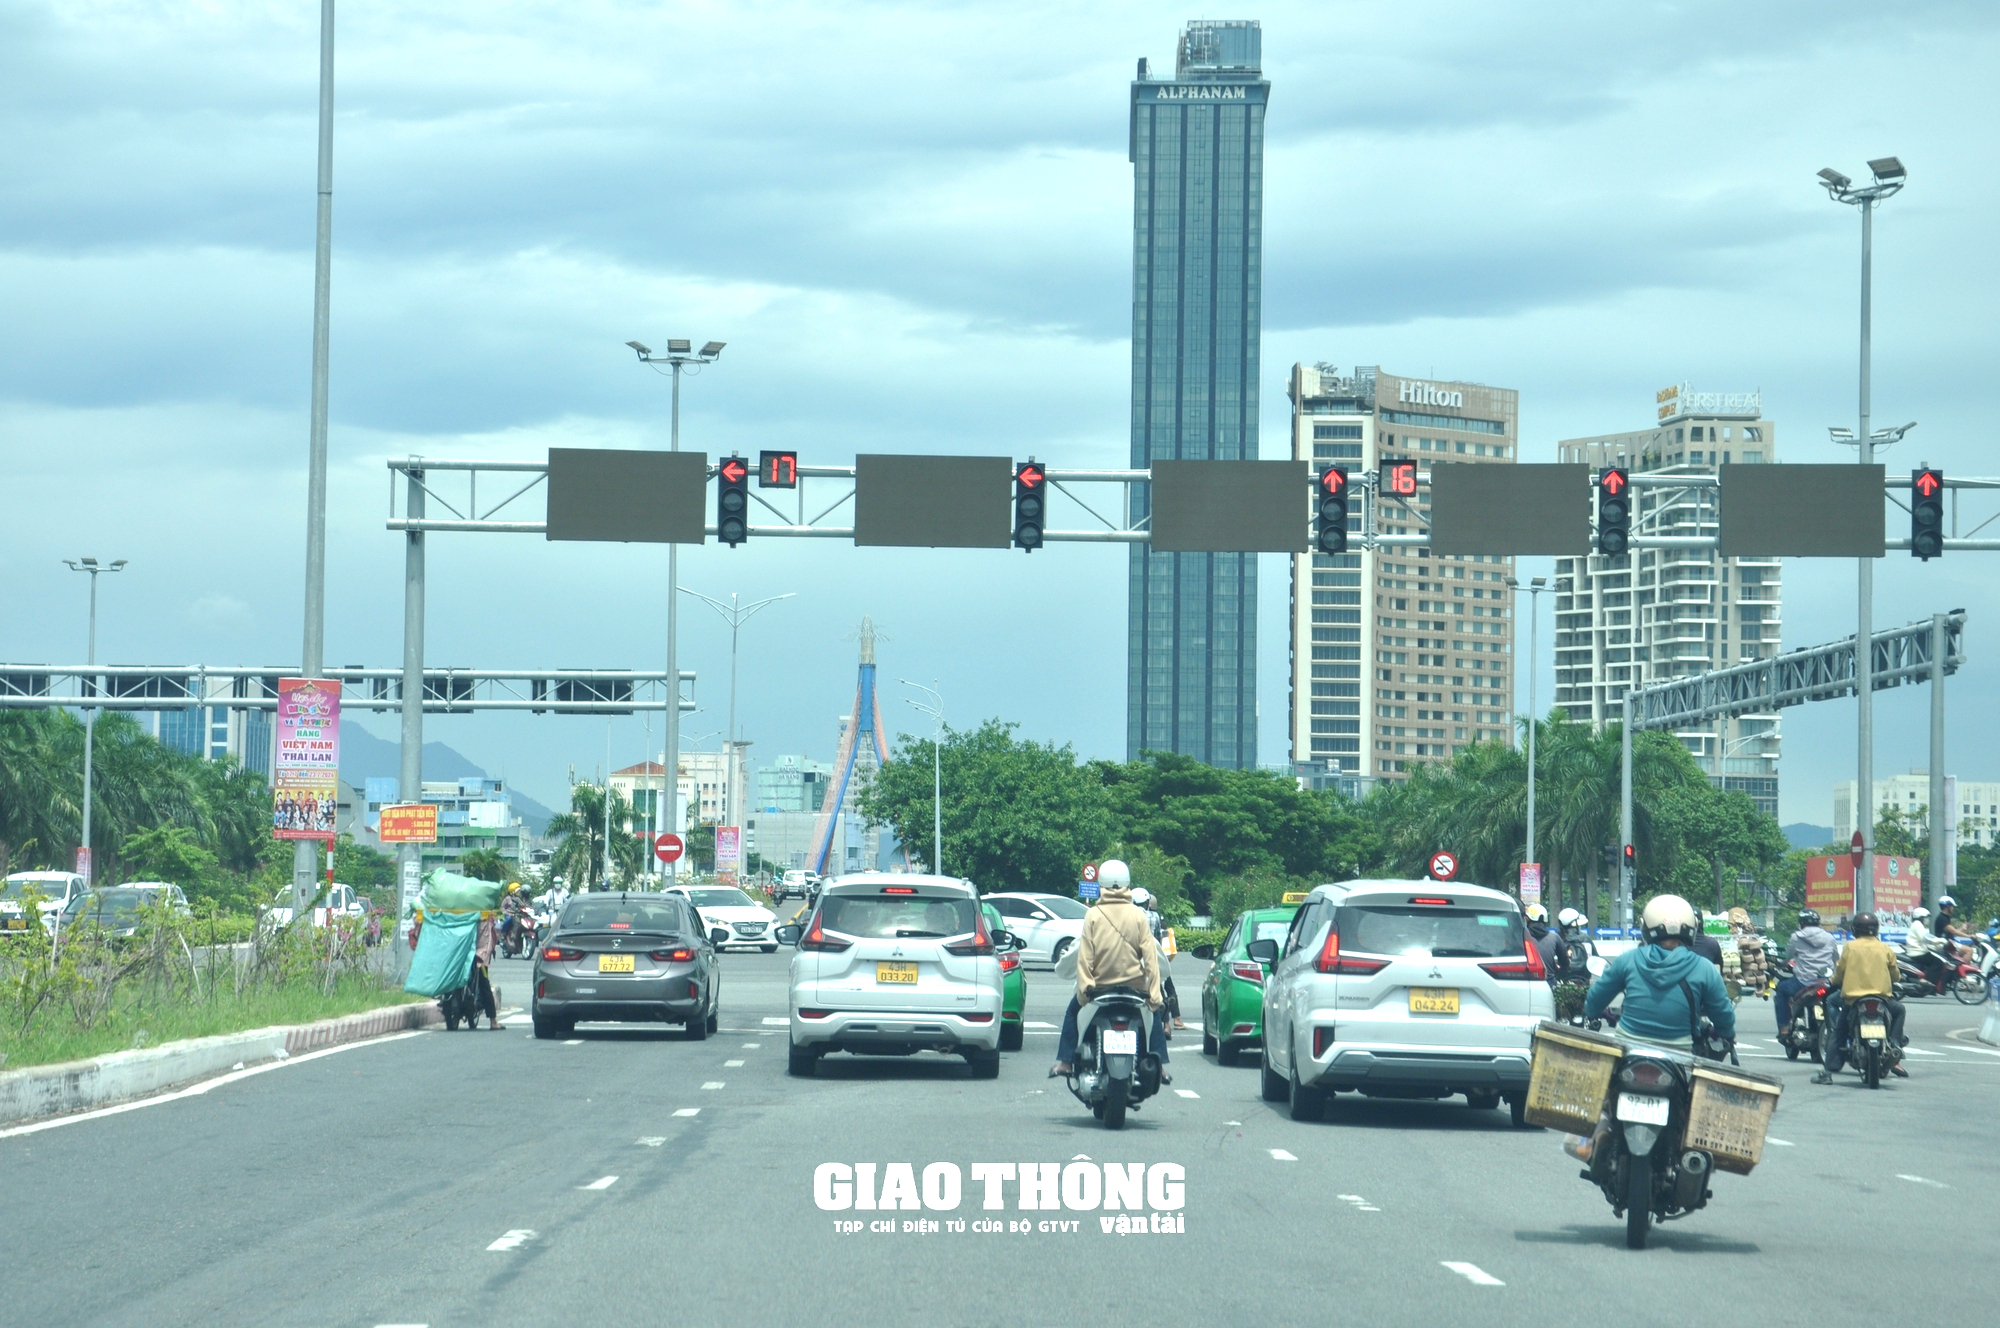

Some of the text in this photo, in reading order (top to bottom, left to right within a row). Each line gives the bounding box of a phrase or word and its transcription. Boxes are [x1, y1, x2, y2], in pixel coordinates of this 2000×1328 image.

[1157, 86, 1246, 99] ALPHANAM
[1399, 380, 1463, 408] Hilton
[1686, 392, 1723, 408] FIRST
[772, 454, 796, 483] 17
[1391, 463, 1415, 494] 16
[282, 739, 333, 751] VIỆT NAM
[282, 751, 332, 761] THÁI LAN
[602, 963, 631, 971] 677.72
[888, 962, 907, 972] 43H
[881, 972, 914, 982] 033.20
[1415, 1000, 1454, 1011] 042.24
